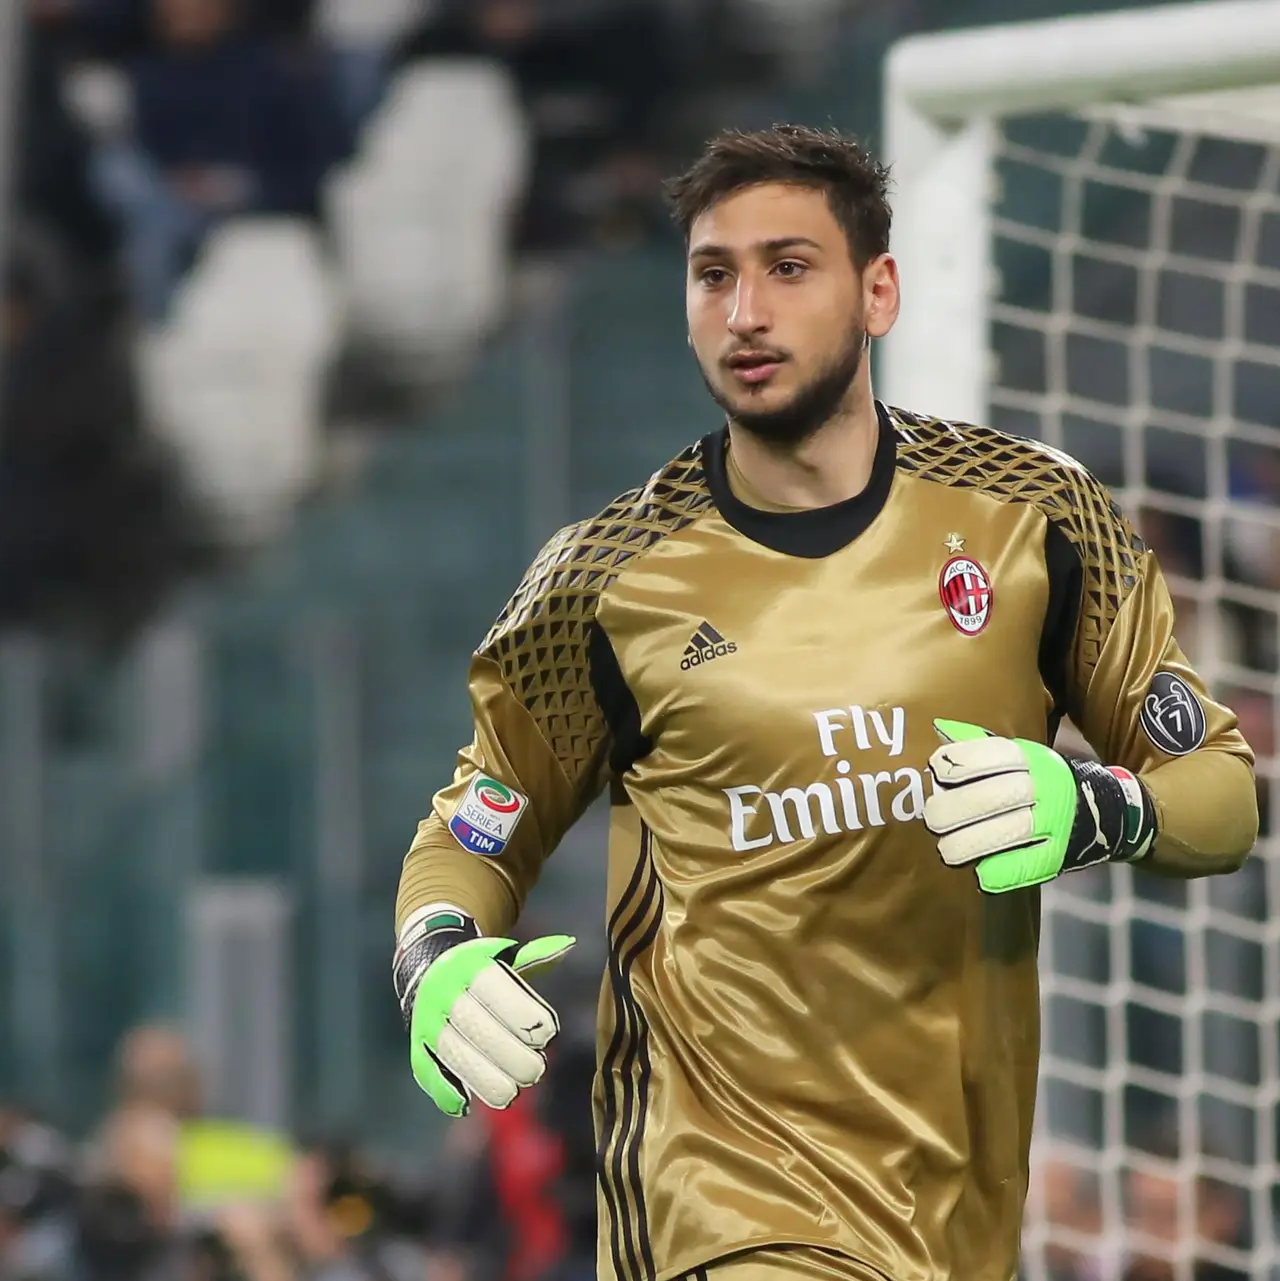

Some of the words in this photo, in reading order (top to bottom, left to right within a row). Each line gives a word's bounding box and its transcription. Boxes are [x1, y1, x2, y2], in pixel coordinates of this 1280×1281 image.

[948, 562, 977, 577] ACM
[960, 615, 982, 626] 1899
[680, 642, 738, 671] adidas
[812, 704, 905, 757] Fly
[1168, 708, 1183, 733] 7
[721, 759, 932, 852] Emira
[463, 804, 494, 830] SERIE
[492, 823, 503, 836] A
[469, 830, 495, 852] TIM
